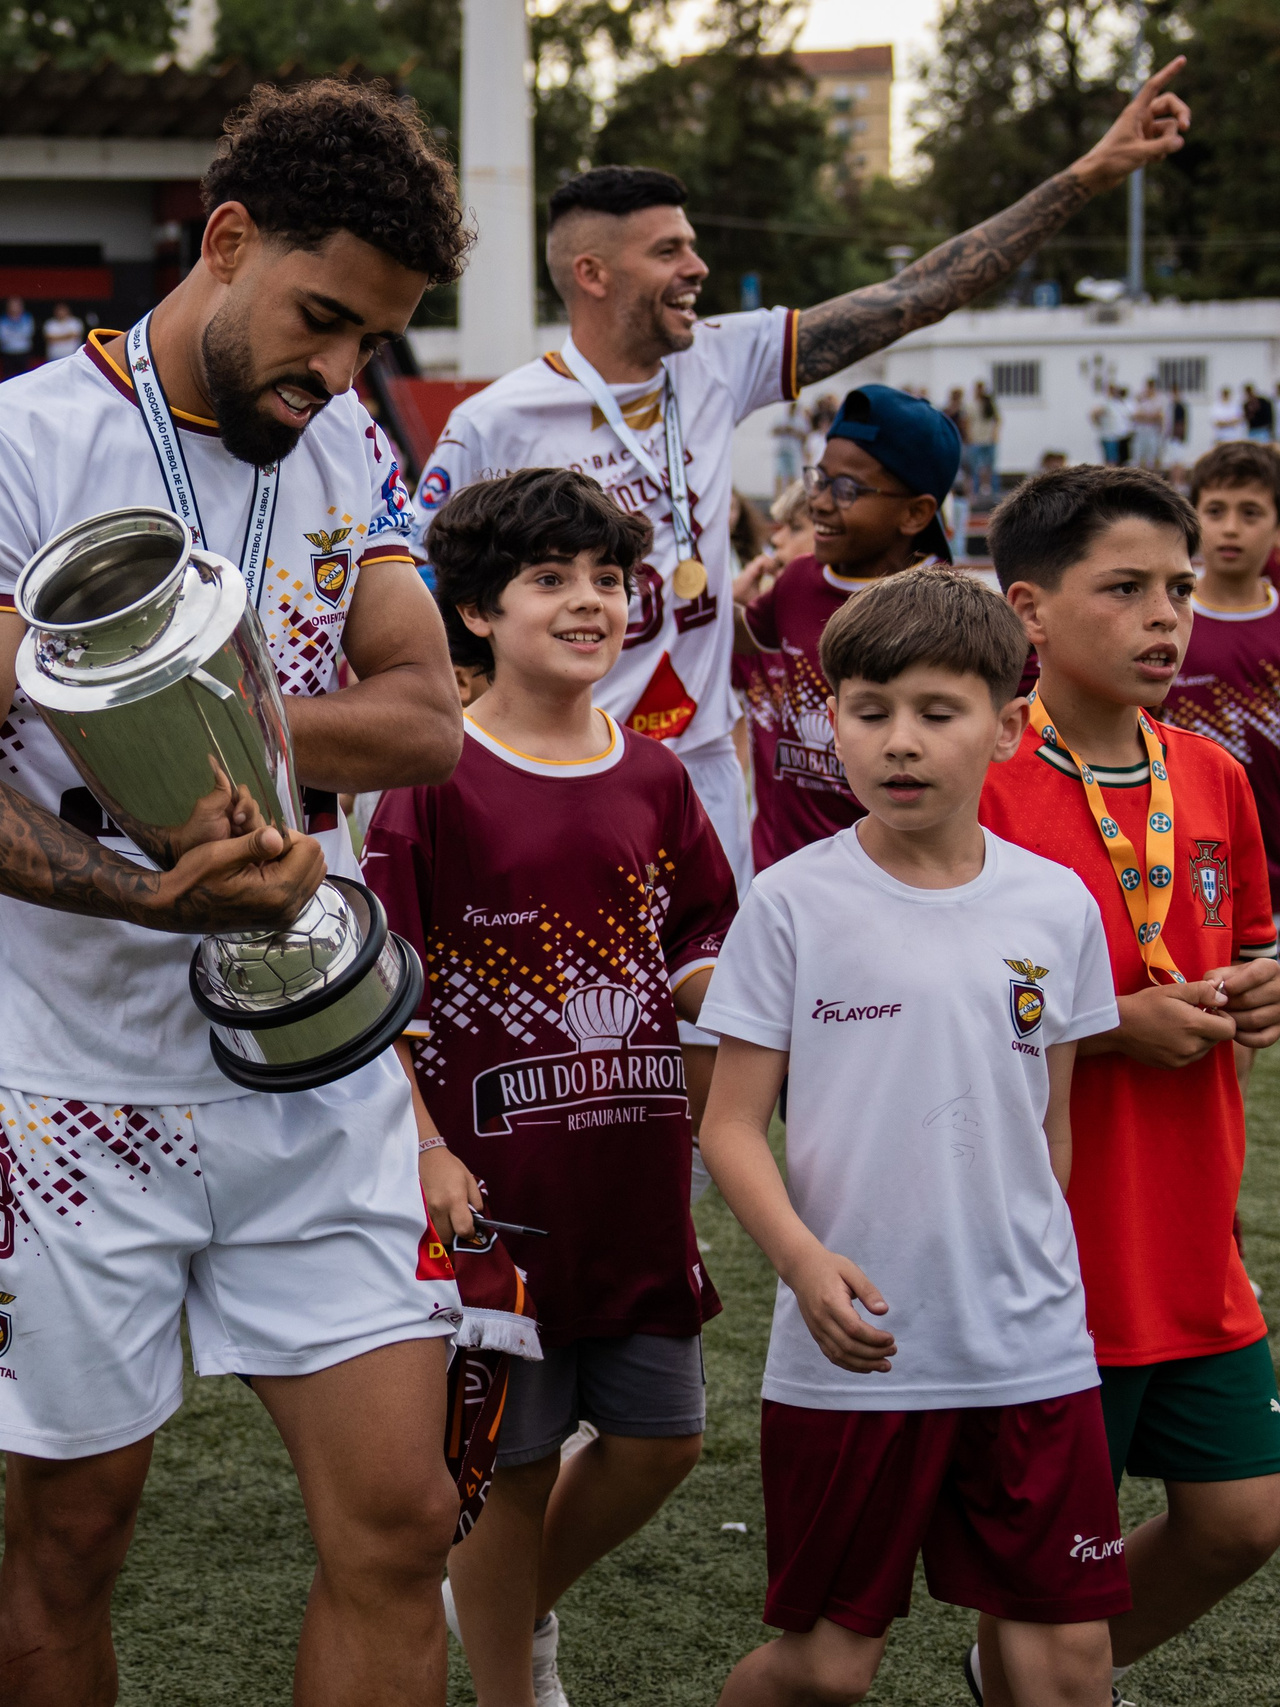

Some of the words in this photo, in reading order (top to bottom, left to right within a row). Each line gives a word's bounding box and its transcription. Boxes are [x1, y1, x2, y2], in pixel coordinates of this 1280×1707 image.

[142, 381, 166, 433] ASSOCIAÇÃO
[160, 433, 177, 473] FUTEBOL
[172, 473, 182, 485] DE
[174, 484, 191, 518] LISBOA
[259, 486, 271, 517] LISBOA
[256, 516, 265, 530] DE
[249, 531, 263, 569] FUTEBOL
[473, 909, 539, 927] PLAYOFF
[823, 1003, 902, 1024] PLAYOFF
[498, 1067, 548, 1107] RUI
[555, 1061, 587, 1099] DO
[567, 1106, 648, 1131] RESTAURANTE
